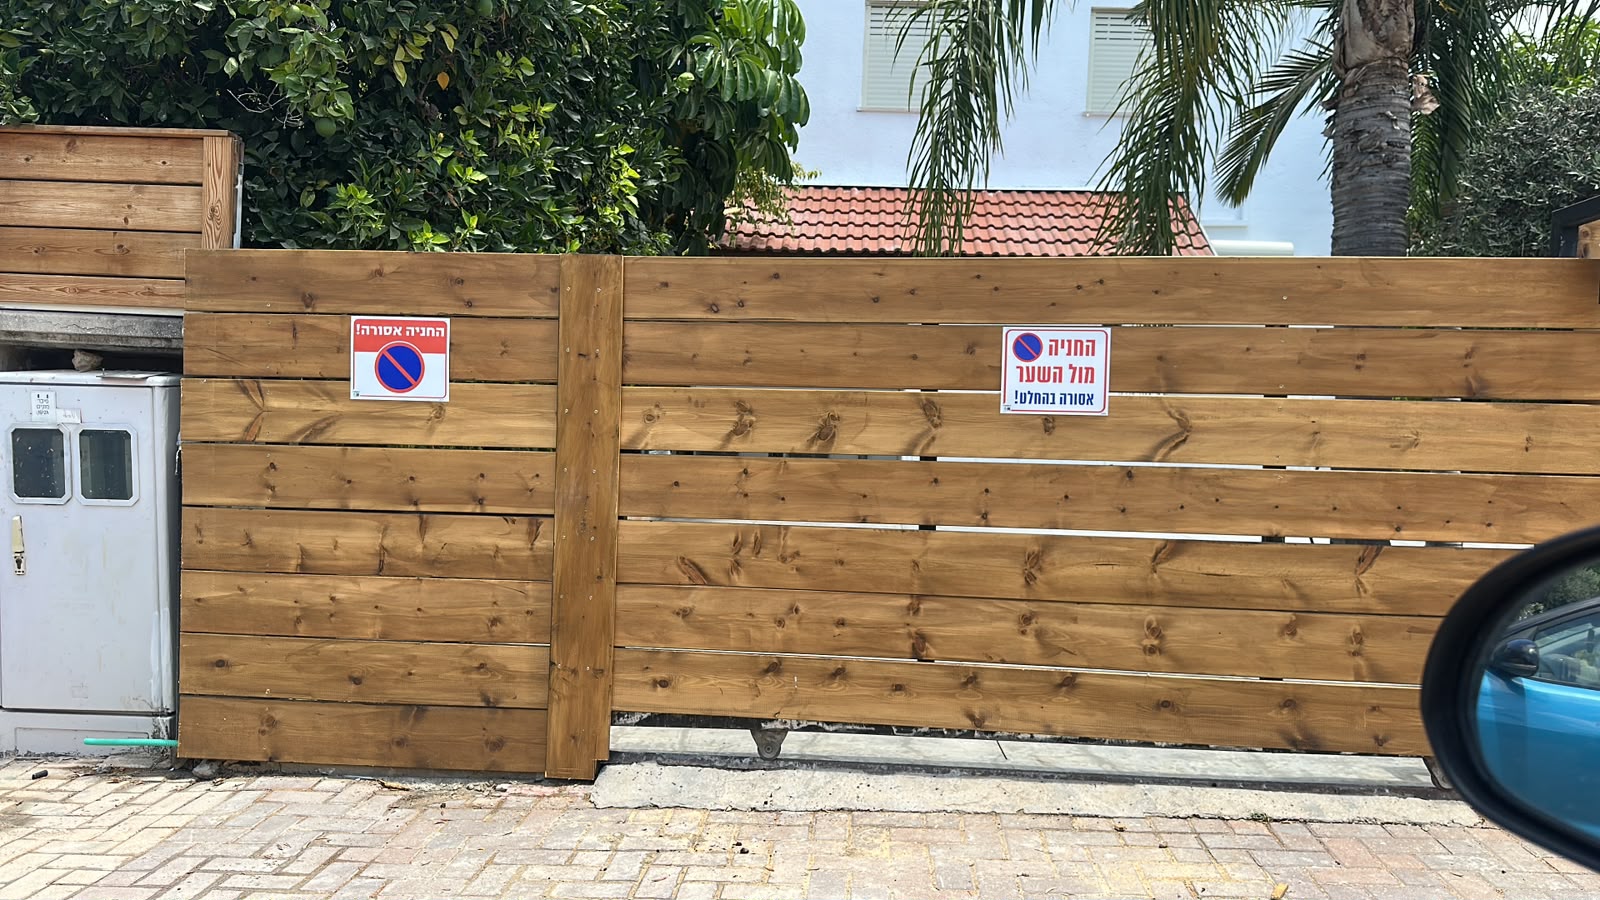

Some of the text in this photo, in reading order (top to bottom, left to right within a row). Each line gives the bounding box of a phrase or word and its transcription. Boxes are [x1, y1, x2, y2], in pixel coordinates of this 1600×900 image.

[356, 323, 445, 337] החניה אסורה!
[1048, 339, 1096, 356] החניה
[1015, 363, 1095, 384] מול השער
[1014, 389, 1094, 406] אסורה בהחלט!
